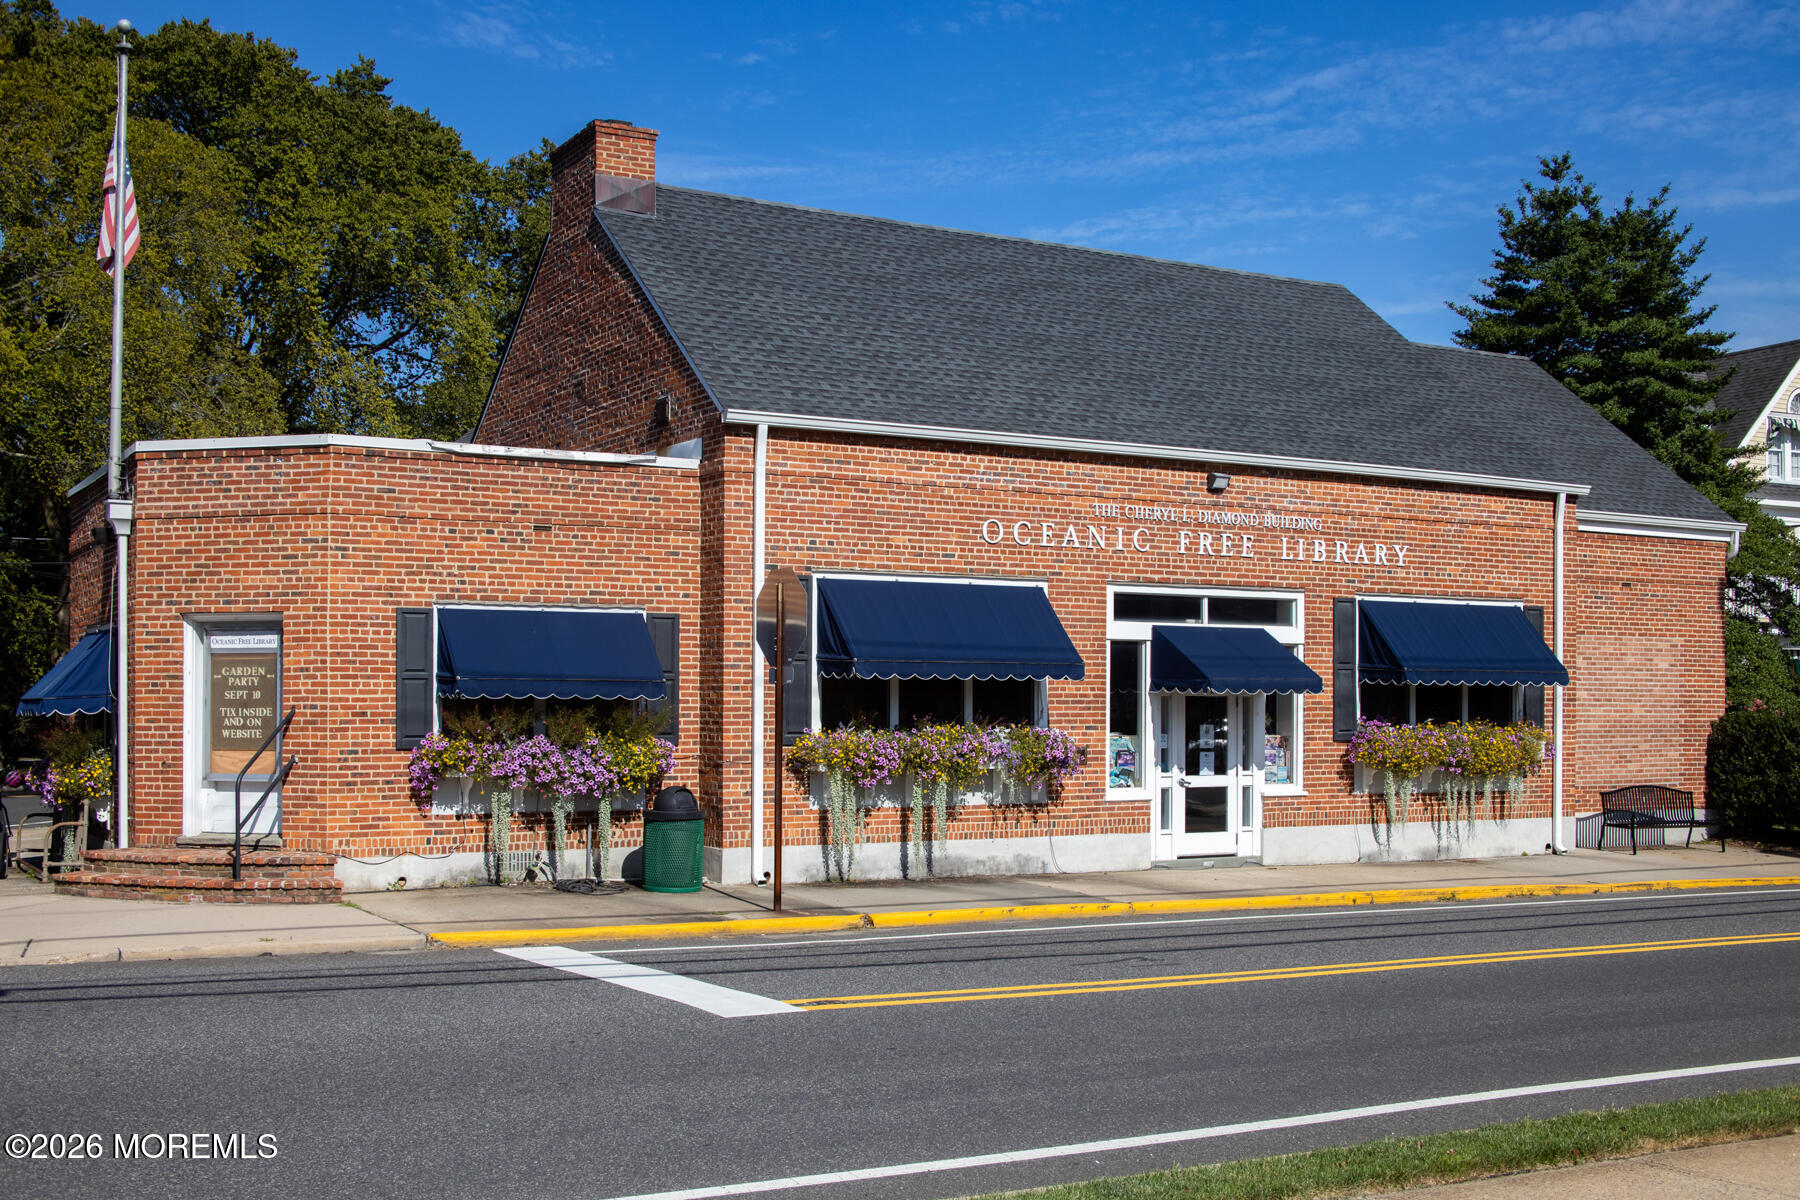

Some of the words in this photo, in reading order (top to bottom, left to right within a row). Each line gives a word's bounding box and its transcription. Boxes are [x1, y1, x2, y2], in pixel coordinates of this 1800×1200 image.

[1092, 504, 1120, 518] THE
[1124, 505, 1178, 522] CHERYL
[1182, 509, 1193, 523] L.
[1198, 510, 1259, 527] DIAMOND
[1263, 515, 1322, 531] BUILDING
[982, 519, 1150, 552] OCEANIC
[1178, 530, 1254, 558] FREE
[1280, 537, 1409, 567] LIBRARY
[221, 667, 265, 676] GARDEN
[228, 677, 260, 686] PARTY
[224, 690, 248, 700] SEPT
[252, 690, 261, 700] 10
[220, 707, 237, 717] TIX
[239, 707, 273, 717] INSIDE
[223, 717, 243, 727] AND
[247, 717, 262, 727] ON
[222, 729, 263, 739] WEBSITE
